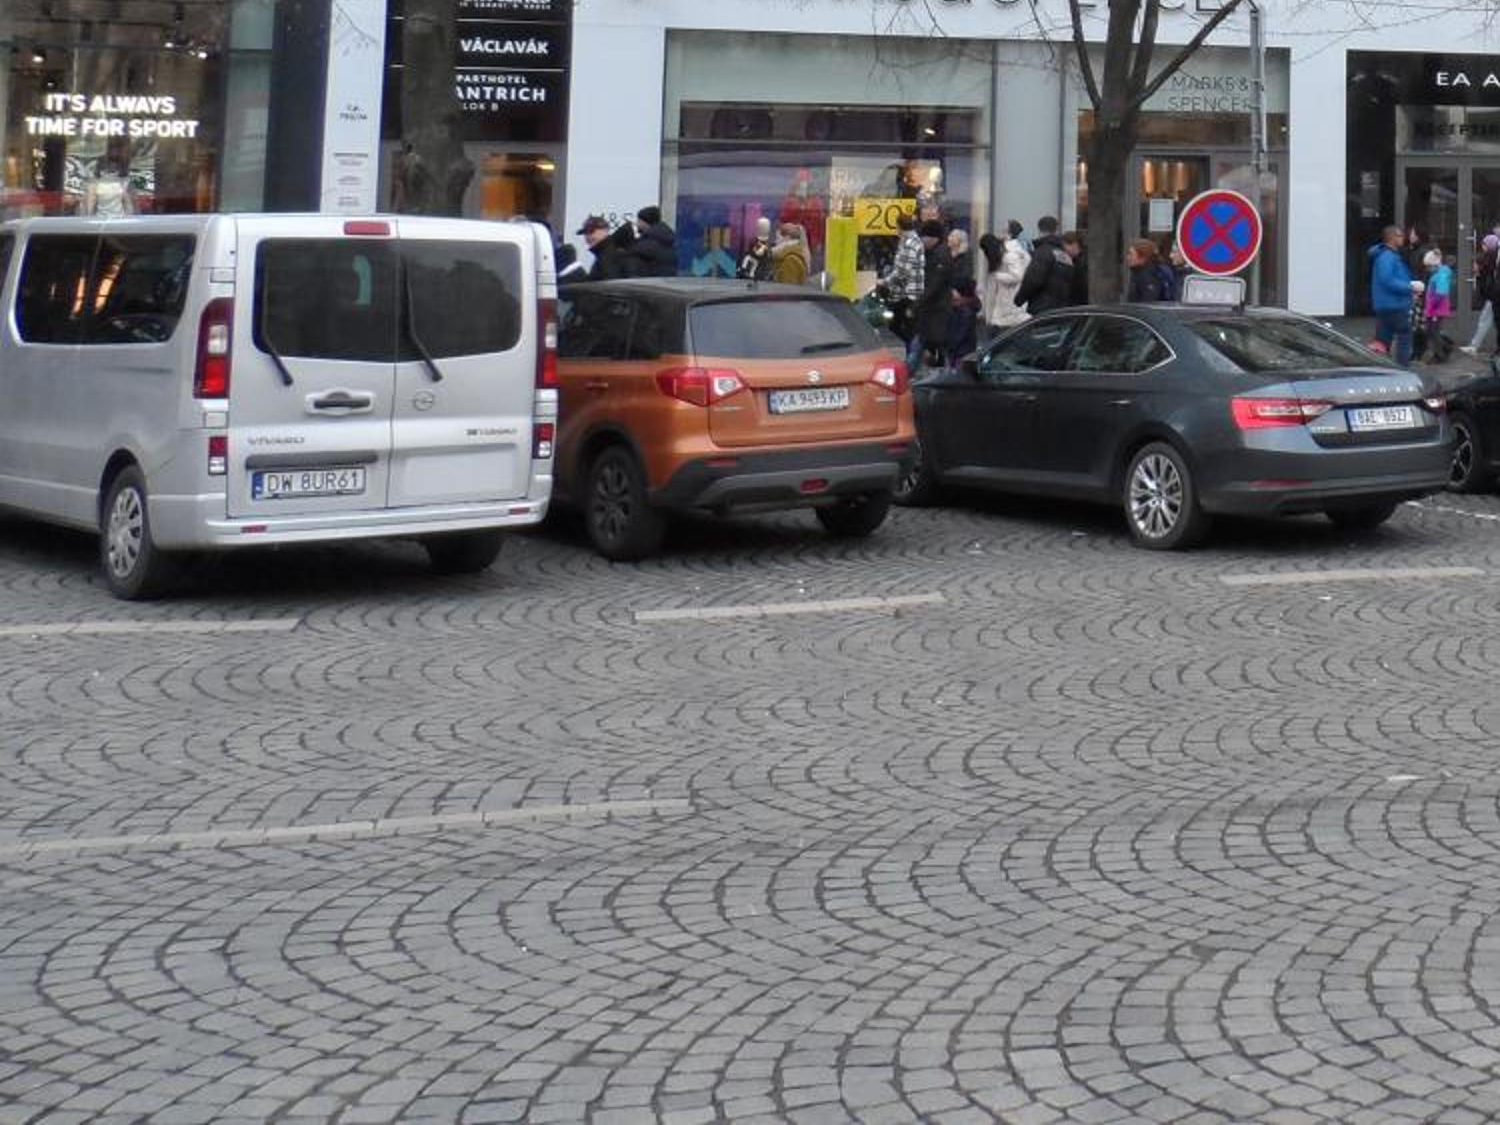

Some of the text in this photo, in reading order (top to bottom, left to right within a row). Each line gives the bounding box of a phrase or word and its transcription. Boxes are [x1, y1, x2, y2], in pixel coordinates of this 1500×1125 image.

[460, 37, 549, 54] VÁCLAVÁK
[456, 75, 527, 84] PARTHOTEL
[1173, 76, 1235, 91] MARKS
[1435, 72, 1471, 87] EA
[45, 94, 176, 114] IT'S ALWAYS
[25, 117, 199, 138] TIME FOR SPORT
[267, 472, 358, 492] DW 8UR61
